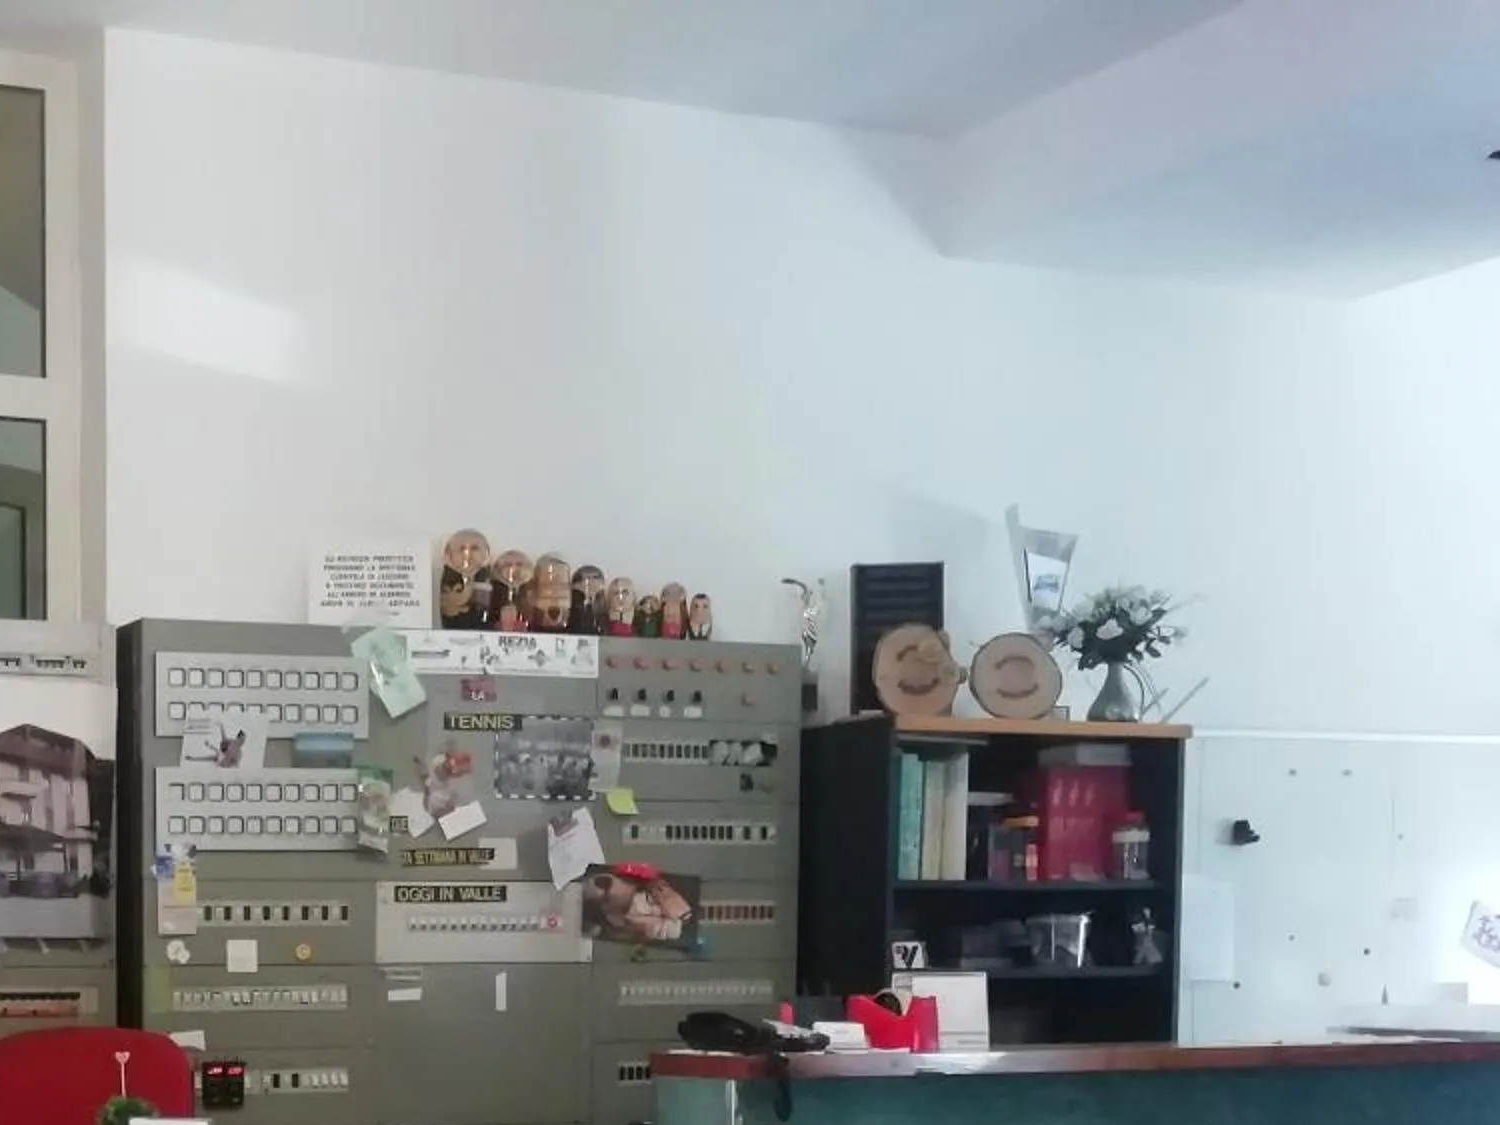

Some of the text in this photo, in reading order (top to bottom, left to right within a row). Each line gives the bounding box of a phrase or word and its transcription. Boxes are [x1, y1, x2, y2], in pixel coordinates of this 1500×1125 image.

[451, 714, 514, 730] TENNIS
[397, 886, 501, 901] OGGI IN VALLE
